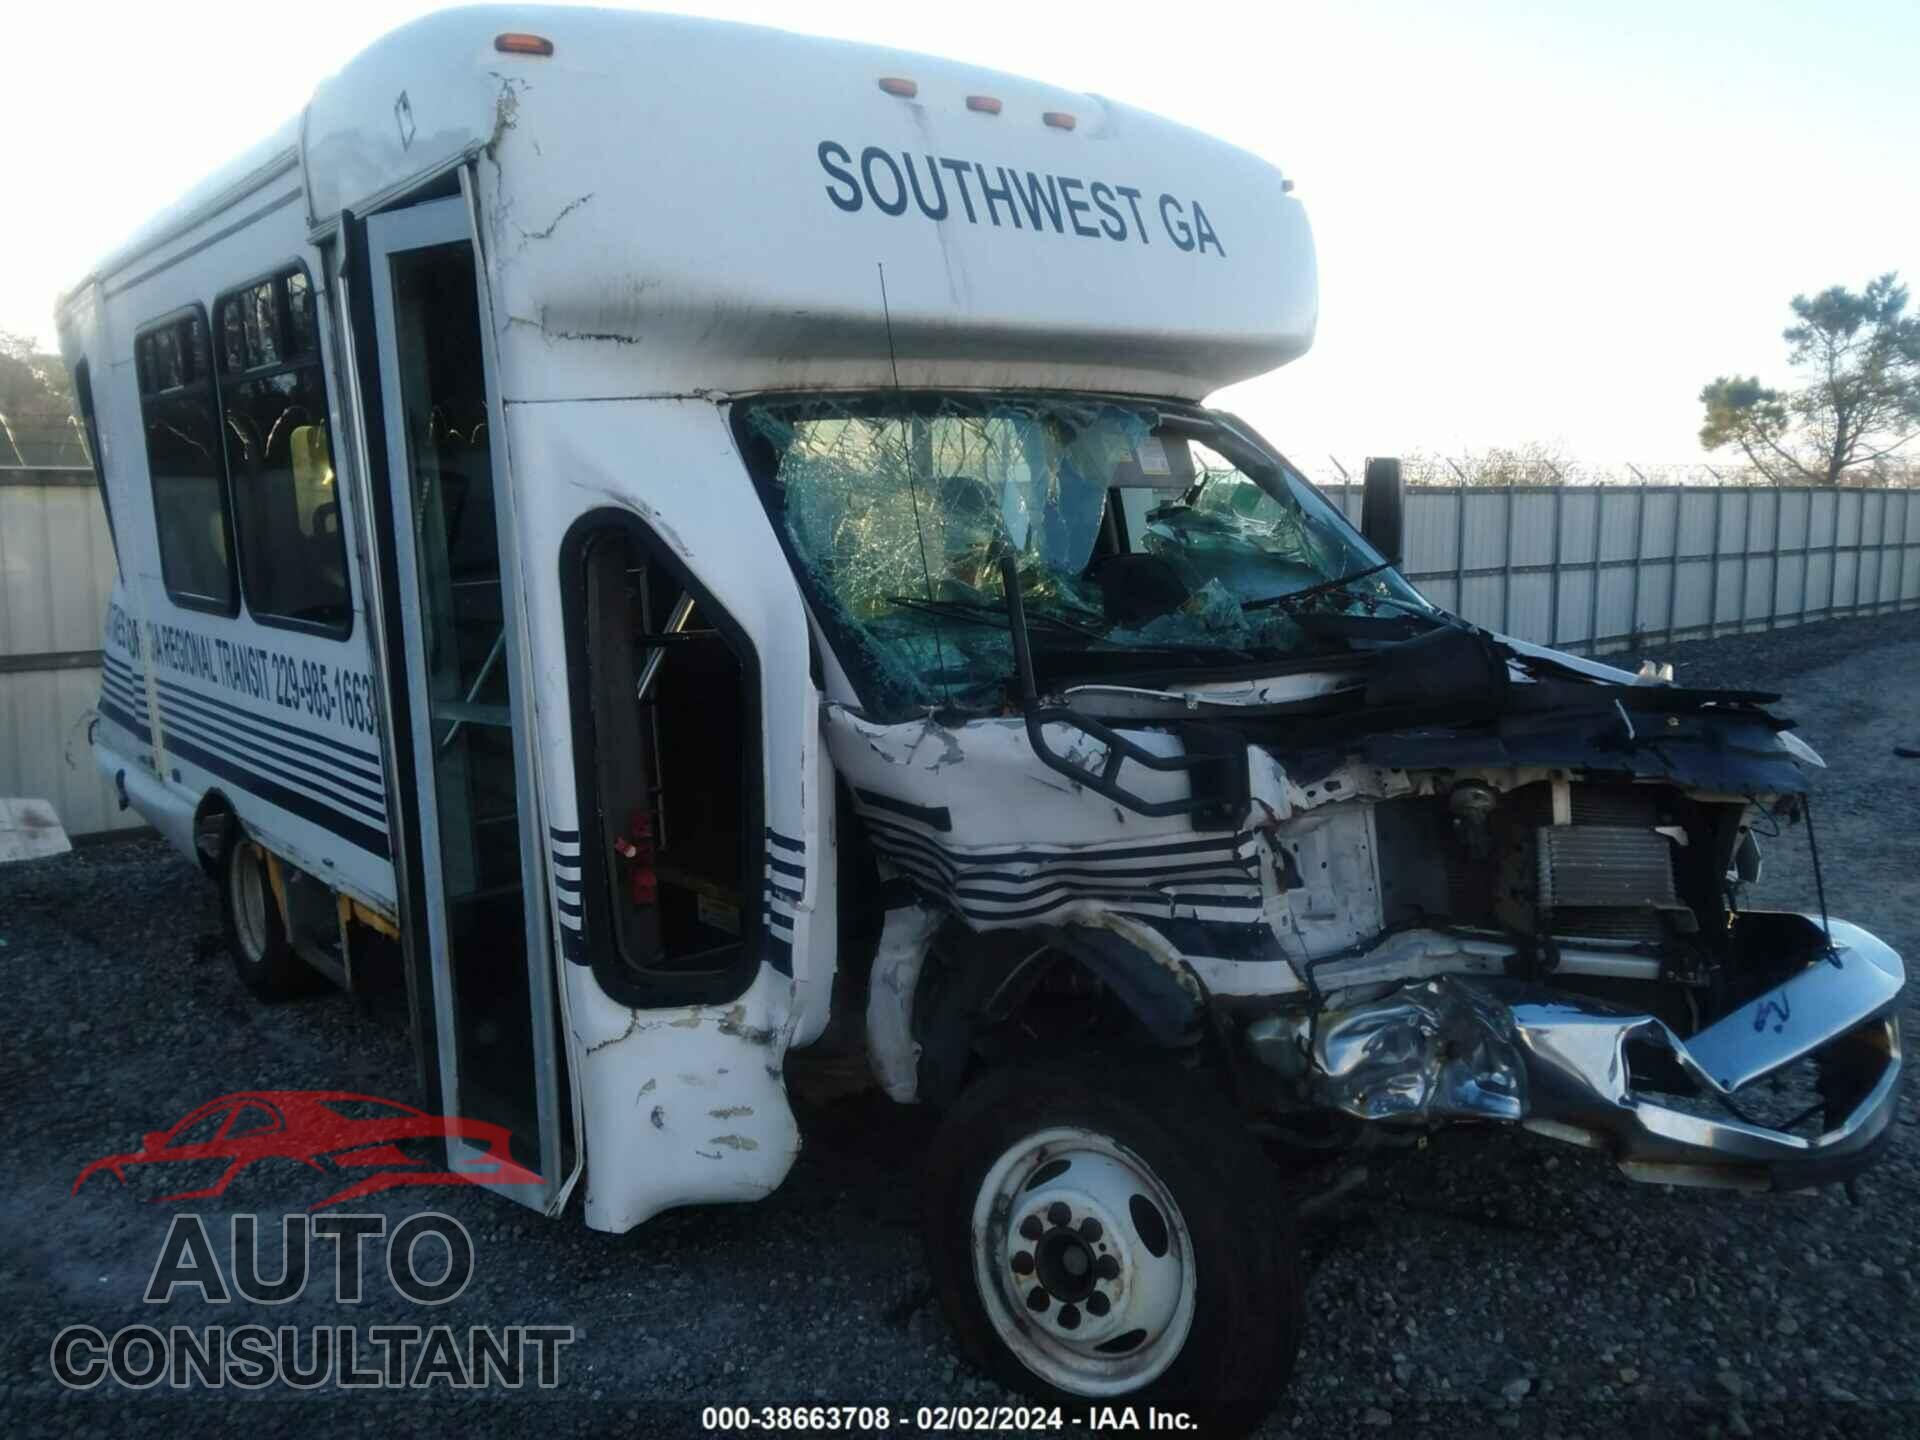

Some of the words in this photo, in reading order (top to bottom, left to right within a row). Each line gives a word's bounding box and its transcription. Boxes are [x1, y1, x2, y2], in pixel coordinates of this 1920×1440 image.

[817, 140, 1150, 244] SOUTHWEST
[1158, 193, 1227, 257] GA
[161, 624, 218, 684] REGIONAL
[214, 638, 270, 702] TRANSIT
[271, 653, 375, 735] 229-985-1663
